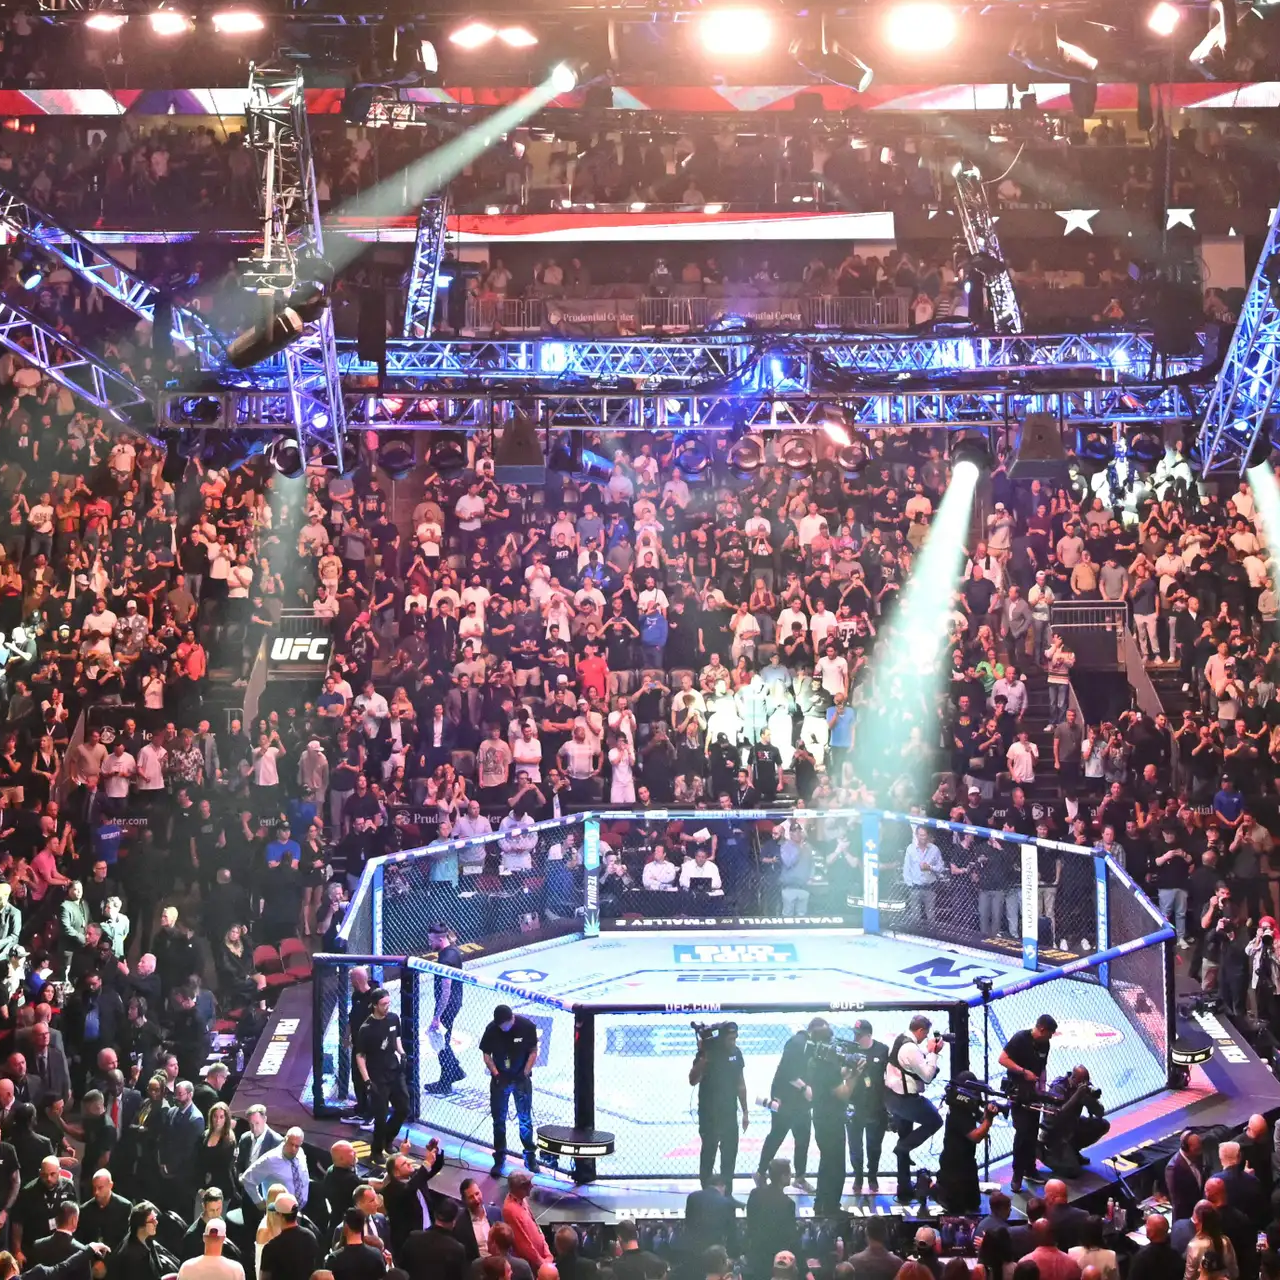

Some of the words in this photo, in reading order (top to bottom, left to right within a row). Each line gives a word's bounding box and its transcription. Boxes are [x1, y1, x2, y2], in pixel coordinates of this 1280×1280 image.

[270, 637, 329, 661] UFC
[586, 875, 598, 910] TEQUILA
[412, 960, 445, 974] TOYO
[445, 968, 478, 984] TIRES
[494, 981, 527, 998] TOYO
[526, 990, 564, 1009] TIRES
[829, 1000, 864, 1011] @UFC
[665, 1003, 721, 1012] UFC.COM
[956, 1093, 971, 1104] UFC
